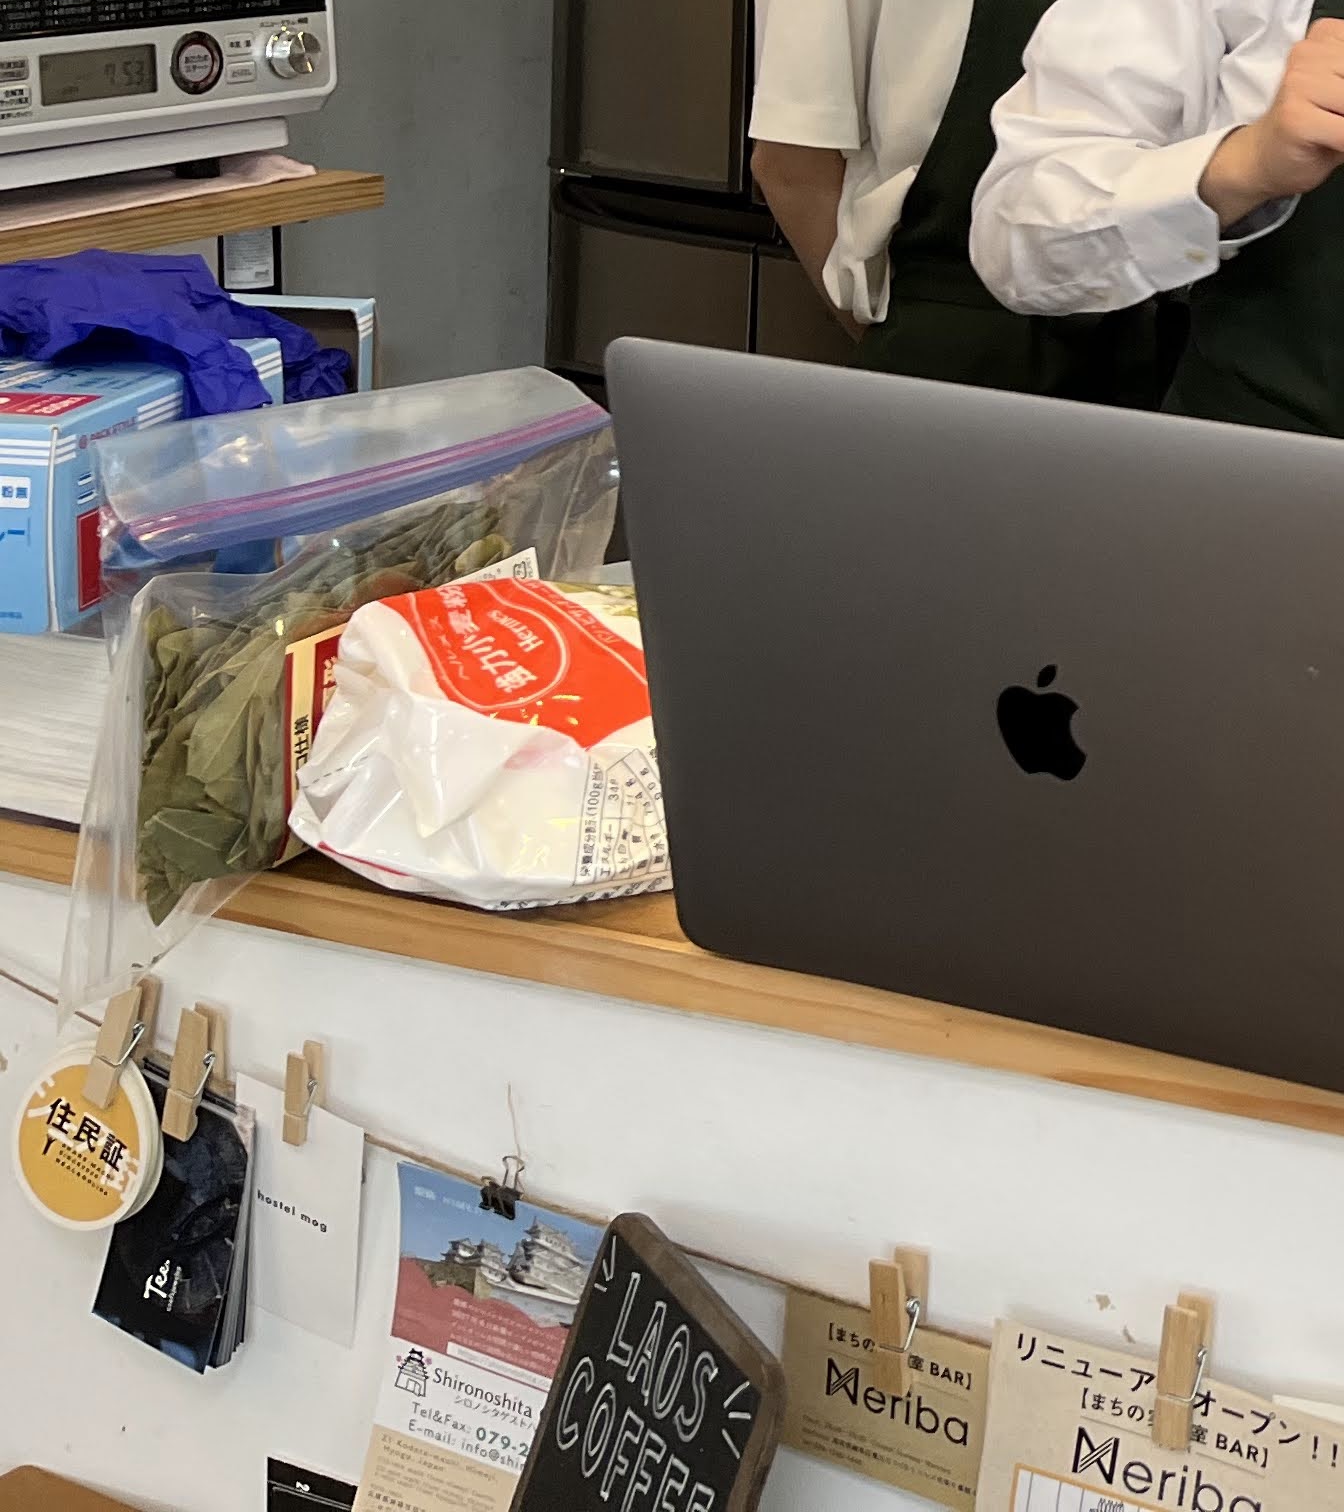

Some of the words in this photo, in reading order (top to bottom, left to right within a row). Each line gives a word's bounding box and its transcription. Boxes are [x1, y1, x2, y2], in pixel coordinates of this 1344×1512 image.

[487, 608, 544, 654] Hermes
[46, 1097, 129, 1173] 住民証
[256, 1189, 296, 1216] hostel
[300, 1212, 328, 1233] mog
[606, 1272, 719, 1442] LAOS
[432, 1366, 533, 1419] Shironoshita
[1017, 1332, 1340, 1469] リニューアオープン!!
[408, 1420, 456, 1447] E-mail:
[412, 1402, 471, 1434] Tel&Fax:
[475, 1426, 529, 1458] 079-2
